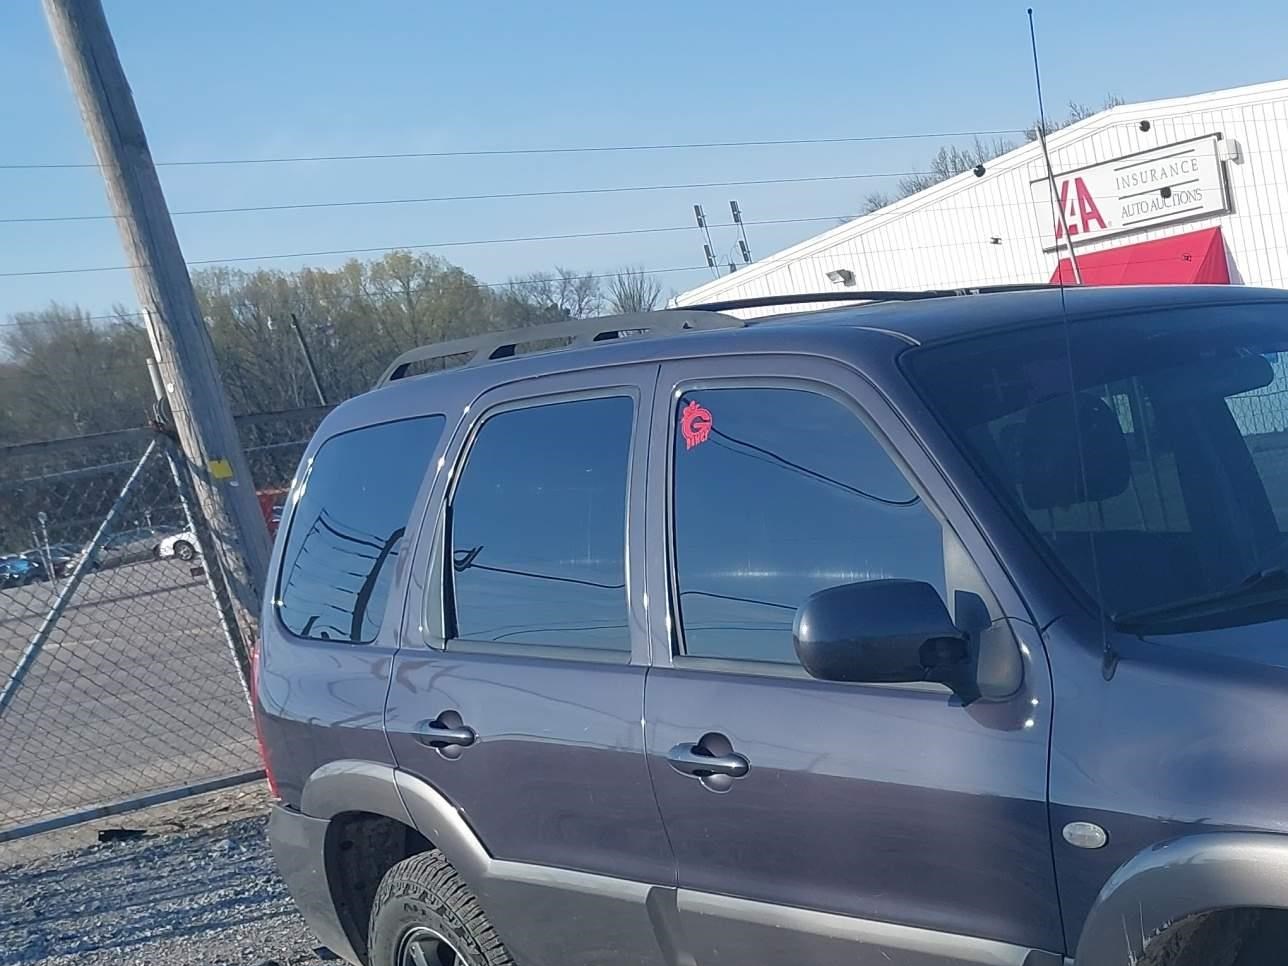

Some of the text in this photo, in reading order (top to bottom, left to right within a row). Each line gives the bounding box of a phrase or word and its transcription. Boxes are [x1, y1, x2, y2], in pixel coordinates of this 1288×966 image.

[1116, 158, 1199, 190] INSURANCE
[1121, 188, 1203, 219] AUTO AUCTIONS
